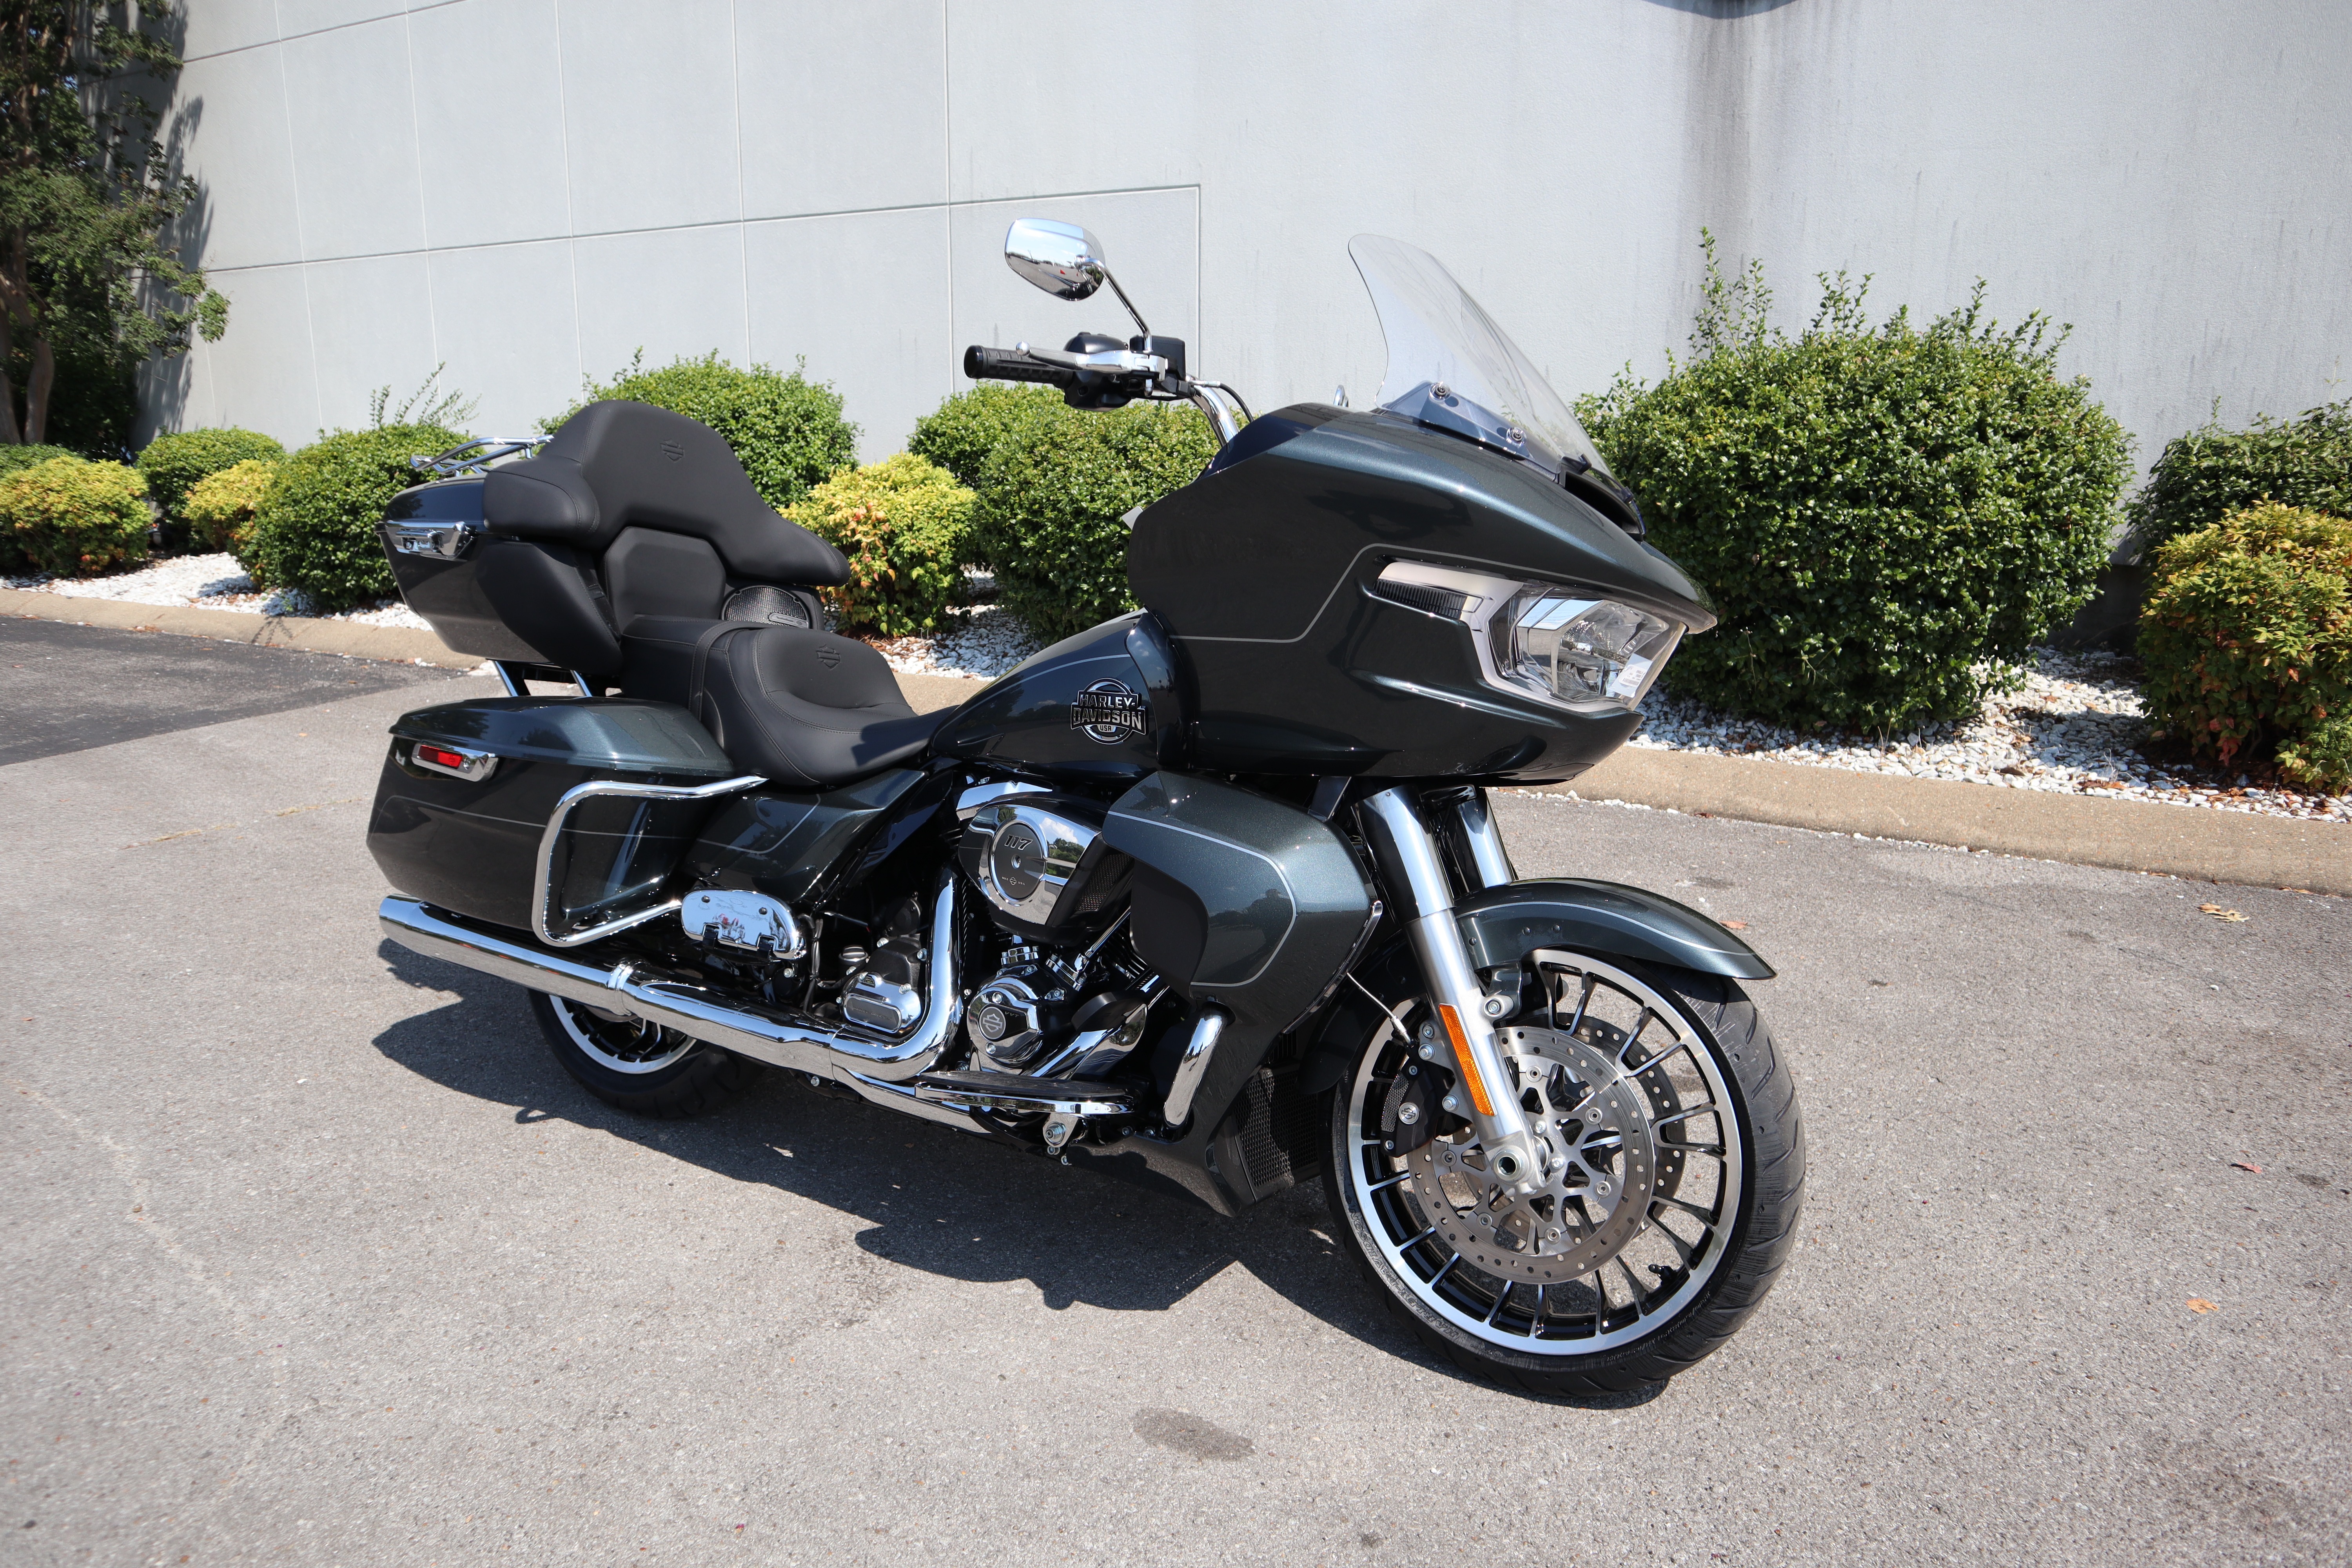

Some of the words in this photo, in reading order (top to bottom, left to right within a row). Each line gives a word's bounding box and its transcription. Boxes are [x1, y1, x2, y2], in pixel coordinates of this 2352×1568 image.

[1080, 694, 1136, 709] HARLEY-
[1073, 707, 1142, 731] DAVIDSON
[1004, 834, 1033, 850] 117
[1348, 1207, 1458, 1337] HARLEY-DAVIDSON
